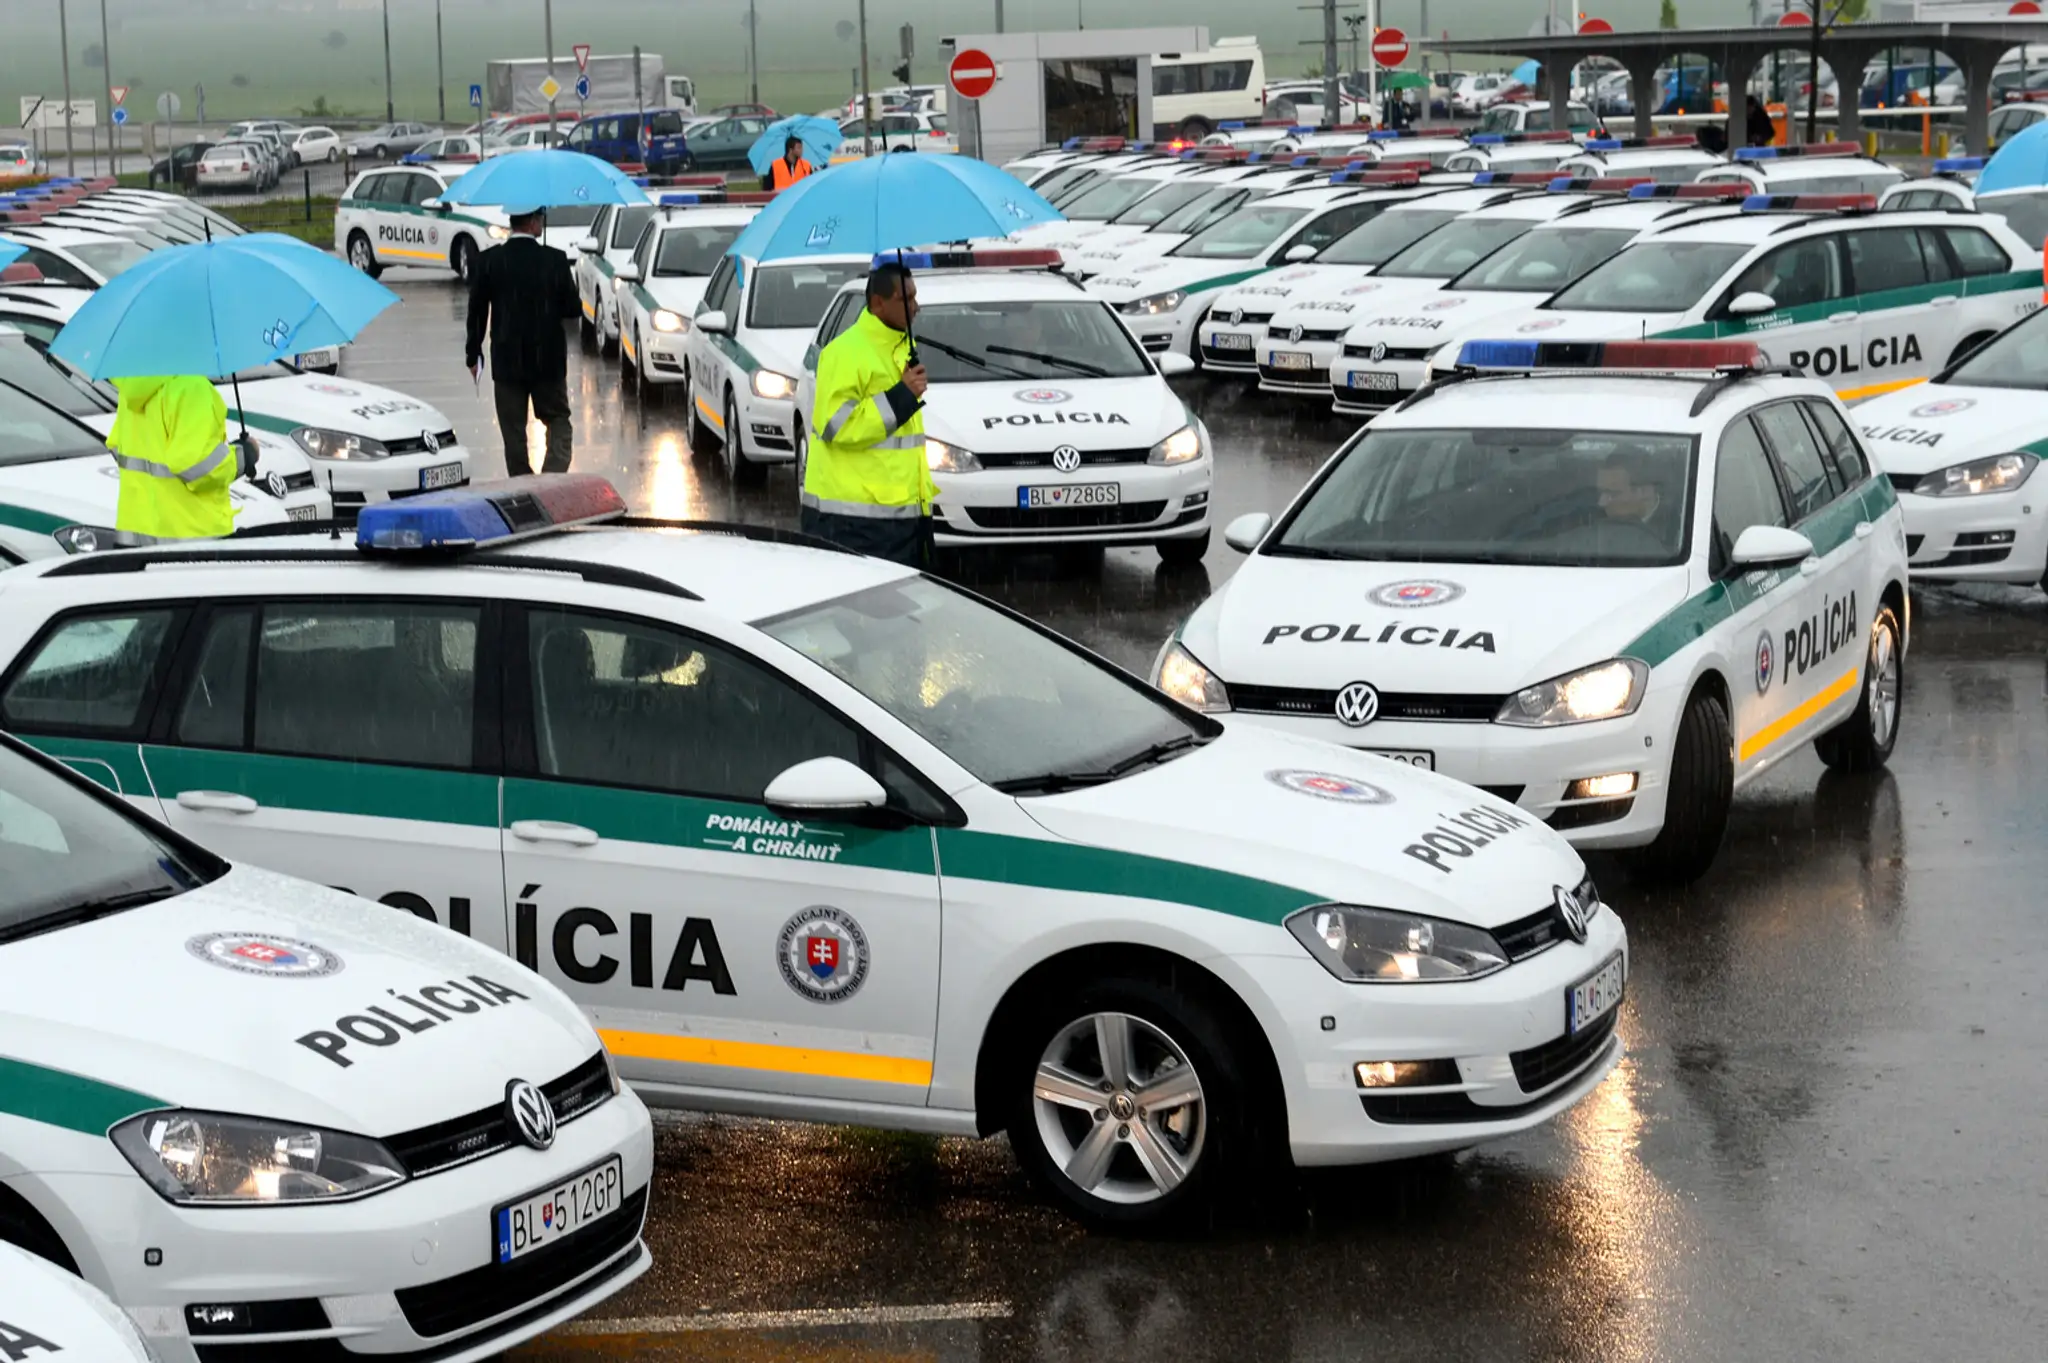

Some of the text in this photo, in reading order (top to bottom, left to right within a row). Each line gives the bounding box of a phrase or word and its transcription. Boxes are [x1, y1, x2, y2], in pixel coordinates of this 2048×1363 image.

[379, 224, 425, 244] POLÍCIA
[982, 410, 1131, 430] POLÍCIA
[1030, 487, 1051, 505] BL
[1061, 486, 1117, 505] 728GS
[1262, 621, 1496, 653] POLÍCIA
[1782, 590, 1857, 685] POLÍCIA
[706, 814, 804, 838] POMÁHAŤ
[1402, 804, 1530, 873] POLÍCIA
[732, 836, 843, 861] A CHRÁNIŤ
[326, 883, 737, 996] ÍCIA
[295, 974, 531, 1068] POLÍCIA
[513, 1204, 543, 1251] BL
[554, 1165, 617, 1232] 512GP
